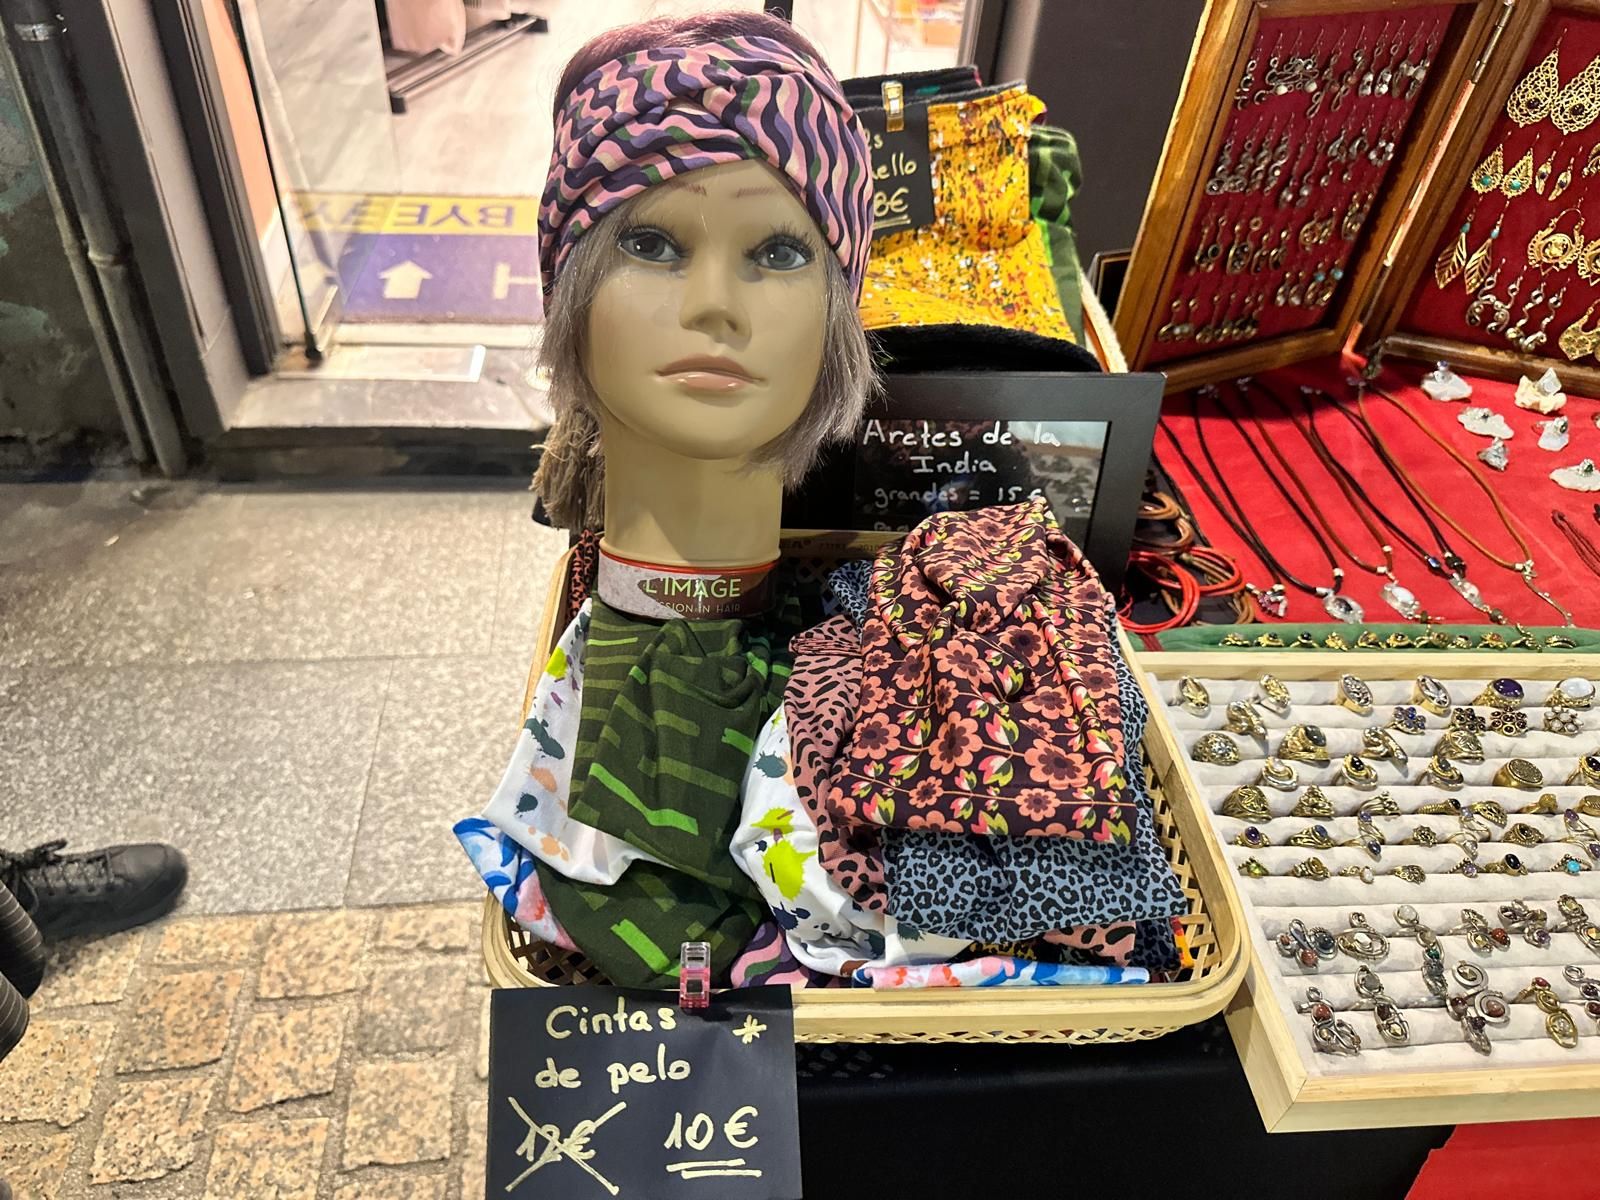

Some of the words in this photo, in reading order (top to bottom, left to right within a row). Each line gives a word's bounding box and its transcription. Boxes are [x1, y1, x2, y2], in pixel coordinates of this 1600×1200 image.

[392, 203, 515, 228] BYE
[982, 421, 1012, 446] de
[1033, 423, 1061, 447] la
[909, 451, 997, 475] India
[874, 482, 959, 509] grandes
[716, 603, 741, 613] HAIR
[545, 996, 677, 1040] Cintas
[534, 1057, 582, 1089] de
[606, 1043, 692, 1094] pelo
